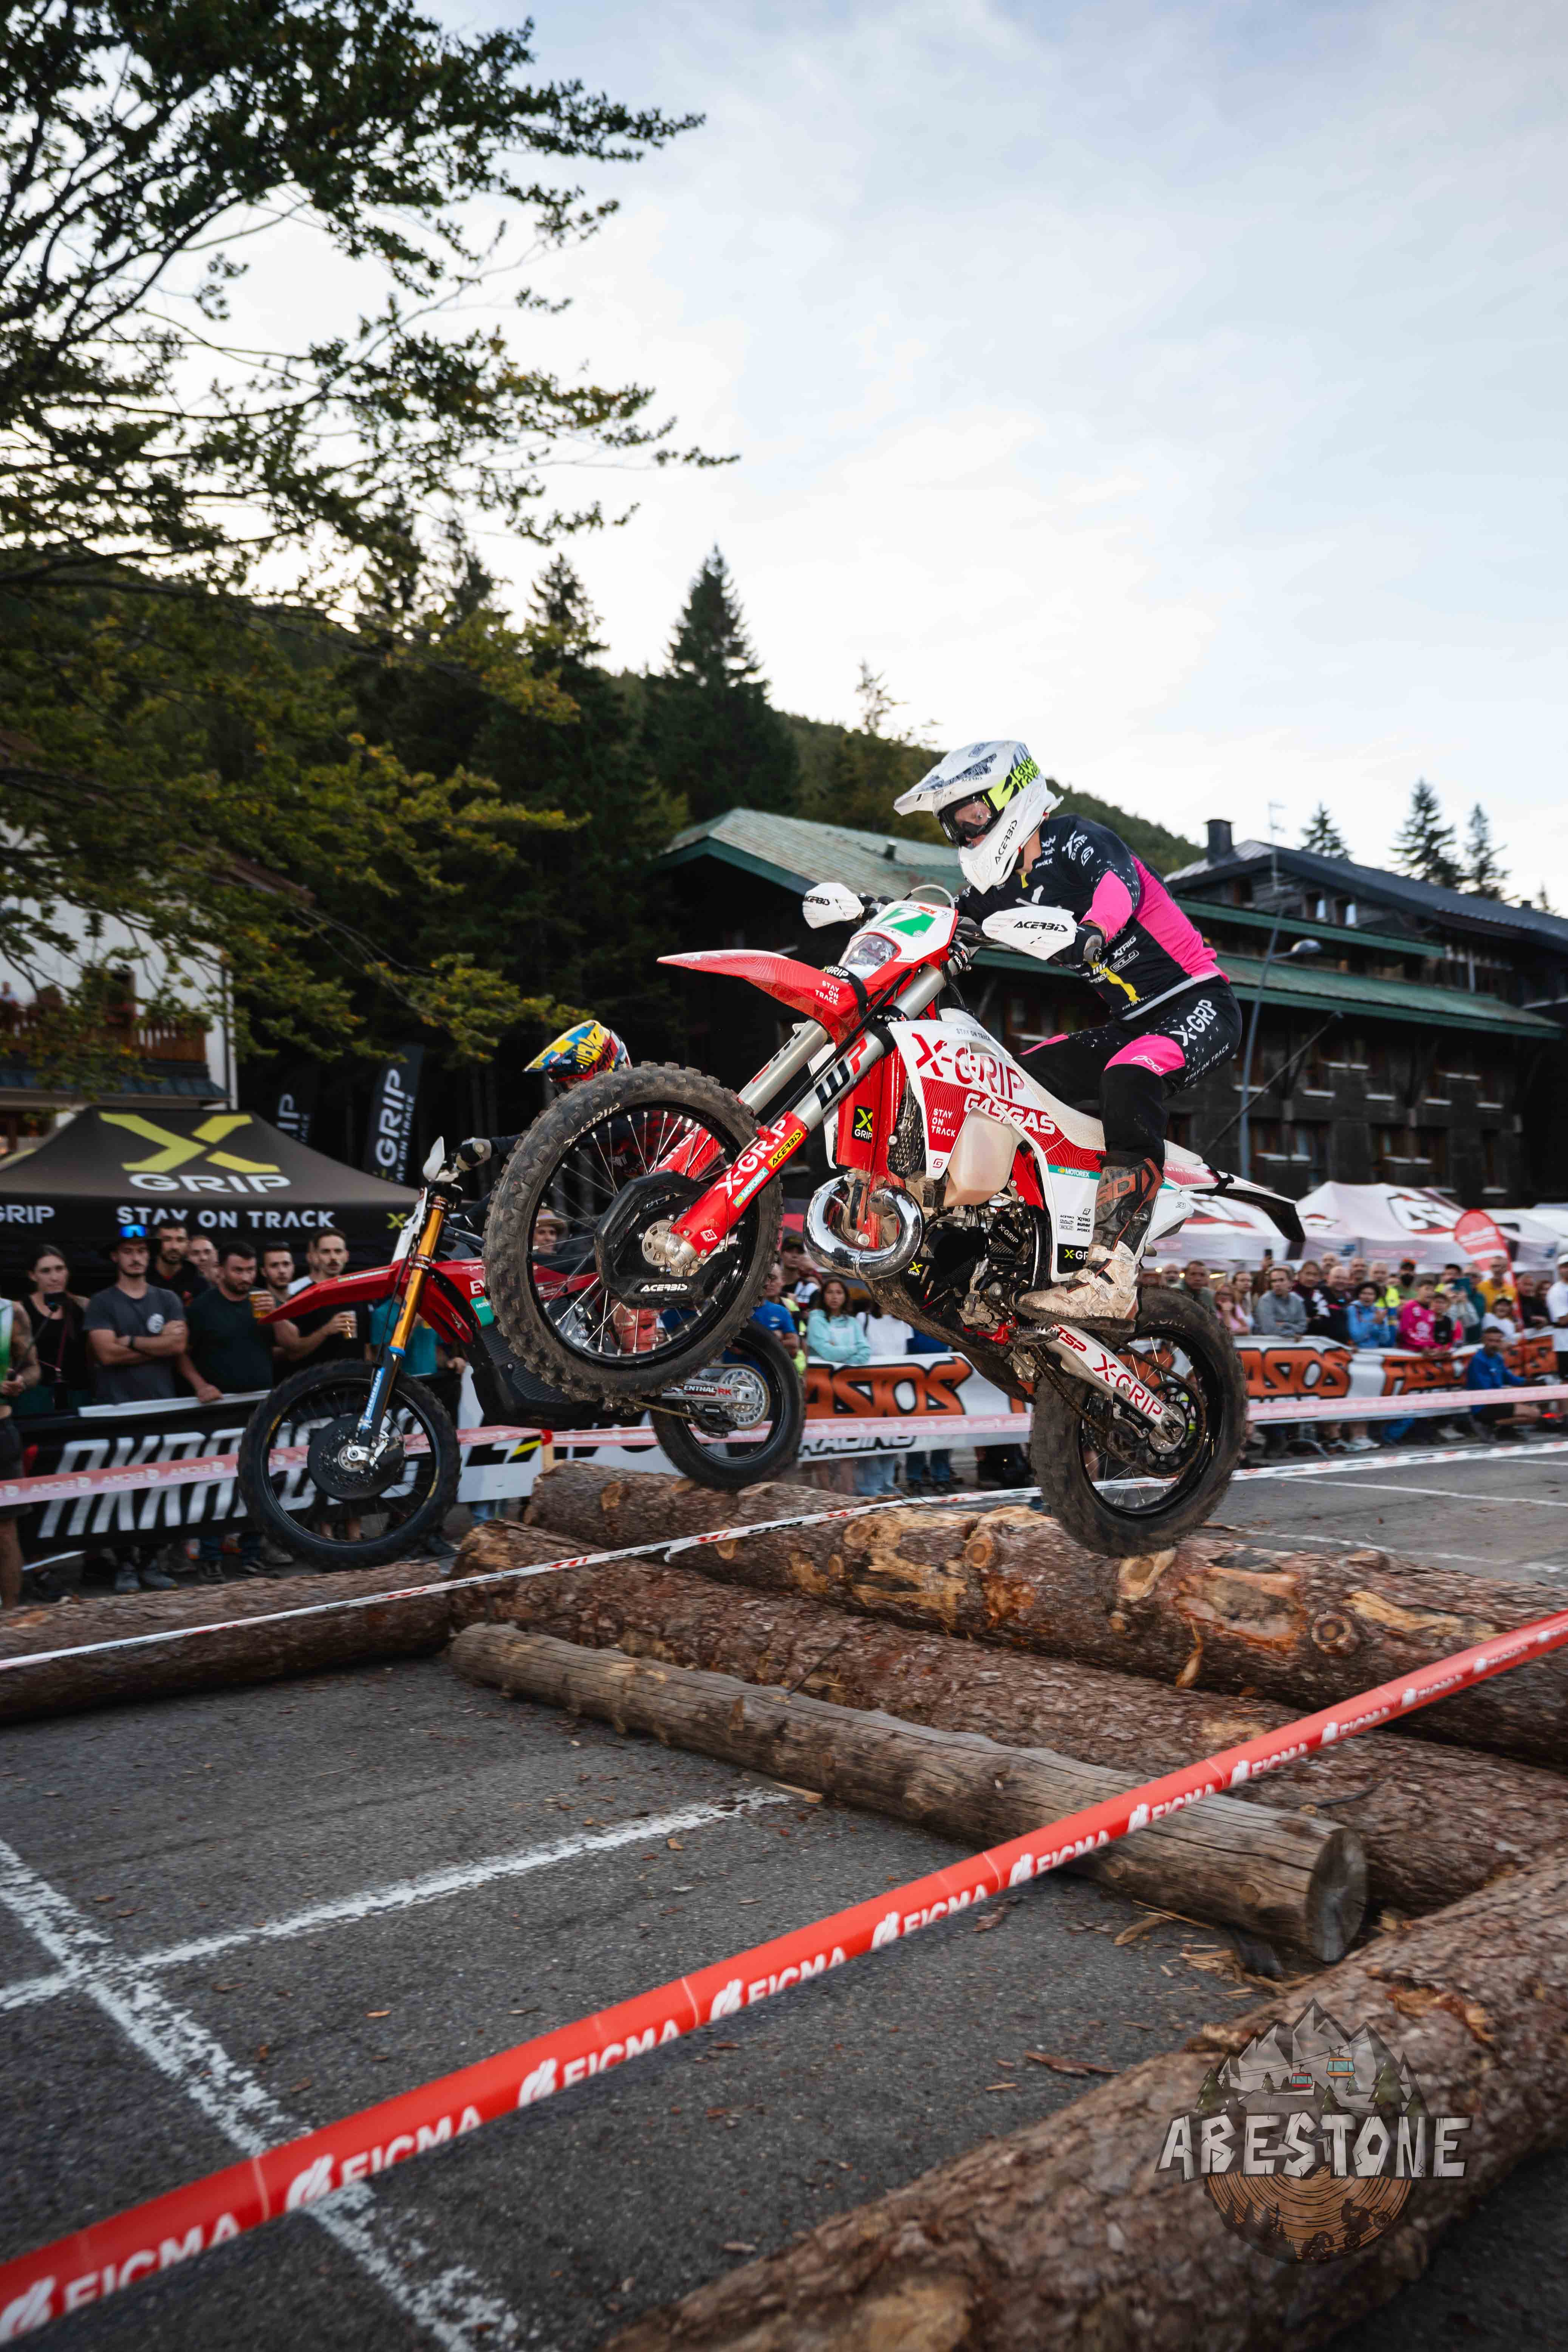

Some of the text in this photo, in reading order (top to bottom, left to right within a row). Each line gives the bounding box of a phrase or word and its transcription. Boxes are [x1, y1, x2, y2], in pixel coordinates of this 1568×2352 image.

[995, 819, 1018, 865] ACERBIS
[1014, 921, 1068, 932] ACERBIS
[1111, 935, 1136, 958] XTRIG
[1113, 951, 1136, 971] SOLO
[815, 989, 838, 1005] TRACK
[822, 980, 840, 993] STAY
[828, 990, 839, 999] ON
[978, 1032, 992, 1041] TRACK
[912, 1033, 1025, 1100] X-GRIP
[1201, 1060, 1210, 1071] ON
[1211, 1042, 1229, 1062] TRACK
[277, 1094, 301, 1130] IP
[375, 1068, 406, 1167] GRIP
[933, 1108, 953, 1119] STAY
[964, 1093, 1056, 1134] GASGAS
[564, 1102, 621, 1146] X-GRIP
[854, 1129, 873, 1138] GRIP
[931, 1126, 956, 1138] TRACK
[772, 1132, 802, 1166] ACERBIS
[129, 1174, 291, 1193] GRIP
[741, 1168, 768, 1197] MOTOREX
[1065, 1169, 1090, 1178] MOTOREX
[117, 1206, 335, 1228] STAY ON TRACK
[997, 1223, 1019, 1244] X-GRIP
[641, 1284, 688, 1292] ACERBIS
[683, 1385, 716, 1393] ENTHAL
[1093, 1353, 1162, 1415] X-GRIP
[746, 1946, 846, 2005] EICMA
[563, 2019, 680, 2088] EICMA
[340, 2105, 482, 2187] EICMA
[63, 2212, 241, 2313] EICMA
